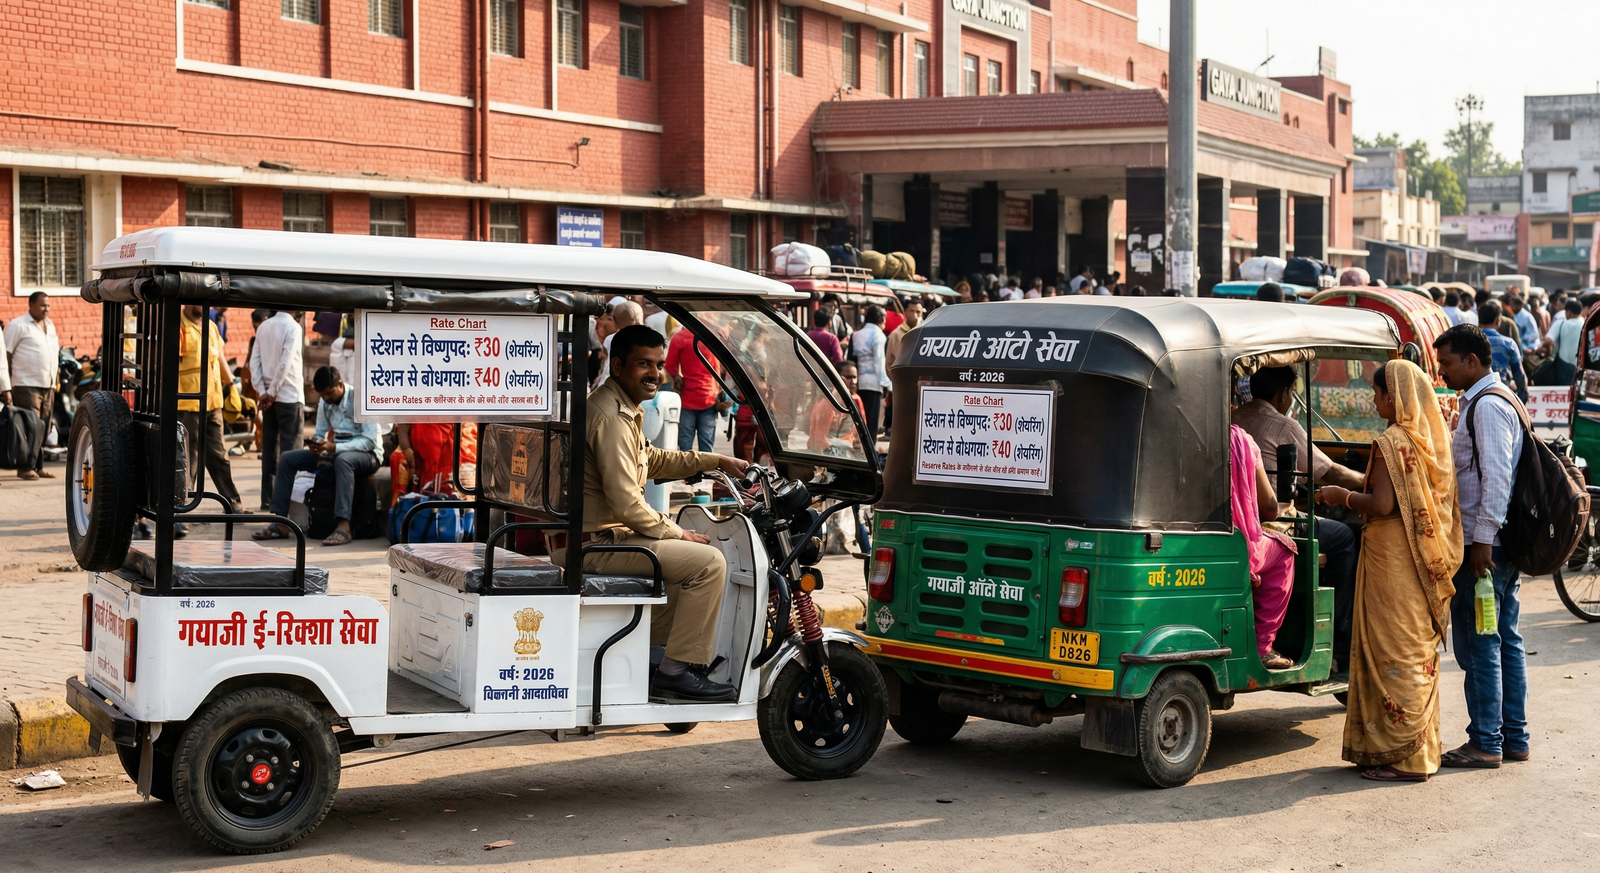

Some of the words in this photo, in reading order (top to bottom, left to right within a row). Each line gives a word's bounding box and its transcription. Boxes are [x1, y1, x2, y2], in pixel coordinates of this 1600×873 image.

[980, 0, 1027, 31] JUNCTION
[1210, 67, 1236, 100] GAYA
[1237, 77, 1280, 114] JUNCTION
[430, 318, 455, 328] Rate
[458, 318, 487, 329] Chart
[370, 332, 404, 356] स्टेशन
[407, 333, 418, 356] से
[474, 336, 500, 357] ₹30
[505, 340, 544, 360] (शेयरिंग)
[919, 330, 981, 358] गयाजी
[1036, 330, 1080, 362] सेवा
[370, 364, 404, 386] स्टेशन
[407, 364, 418, 386] से
[474, 366, 500, 387] ₹40
[505, 370, 544, 390] (शेयरिंग)
[979, 372, 1005, 382] 2026
[370, 395, 400, 404] Reserve
[402, 395, 423, 404] Rates
[964, 395, 981, 405] Rate
[982, 396, 1004, 406] Chart
[924, 408, 946, 428] स्टेशन
[948, 409, 956, 429] से
[993, 412, 1012, 431] ₹30
[1014, 416, 1045, 436] (शेयरिंग)
[923, 435, 946, 455] स्टेशन
[946, 436, 954, 456] से
[992, 440, 1011, 459] ₹40
[1013, 444, 1044, 464] (शेयरिंग)
[922, 460, 942, 470] Reserve
[1175, 568, 1206, 586] 2026
[927, 576, 966, 594] गयाजी
[1000, 580, 1024, 601] सेवा
[196, 600, 215, 608] 2026
[178, 611, 248, 646] गयाजी
[253, 610, 334, 650] ई-रिक्शा
[340, 610, 379, 645] सेवा
[1062, 632, 1088, 646] NKM
[1059, 646, 1090, 662] D826
[522, 668, 554, 680] 2026
